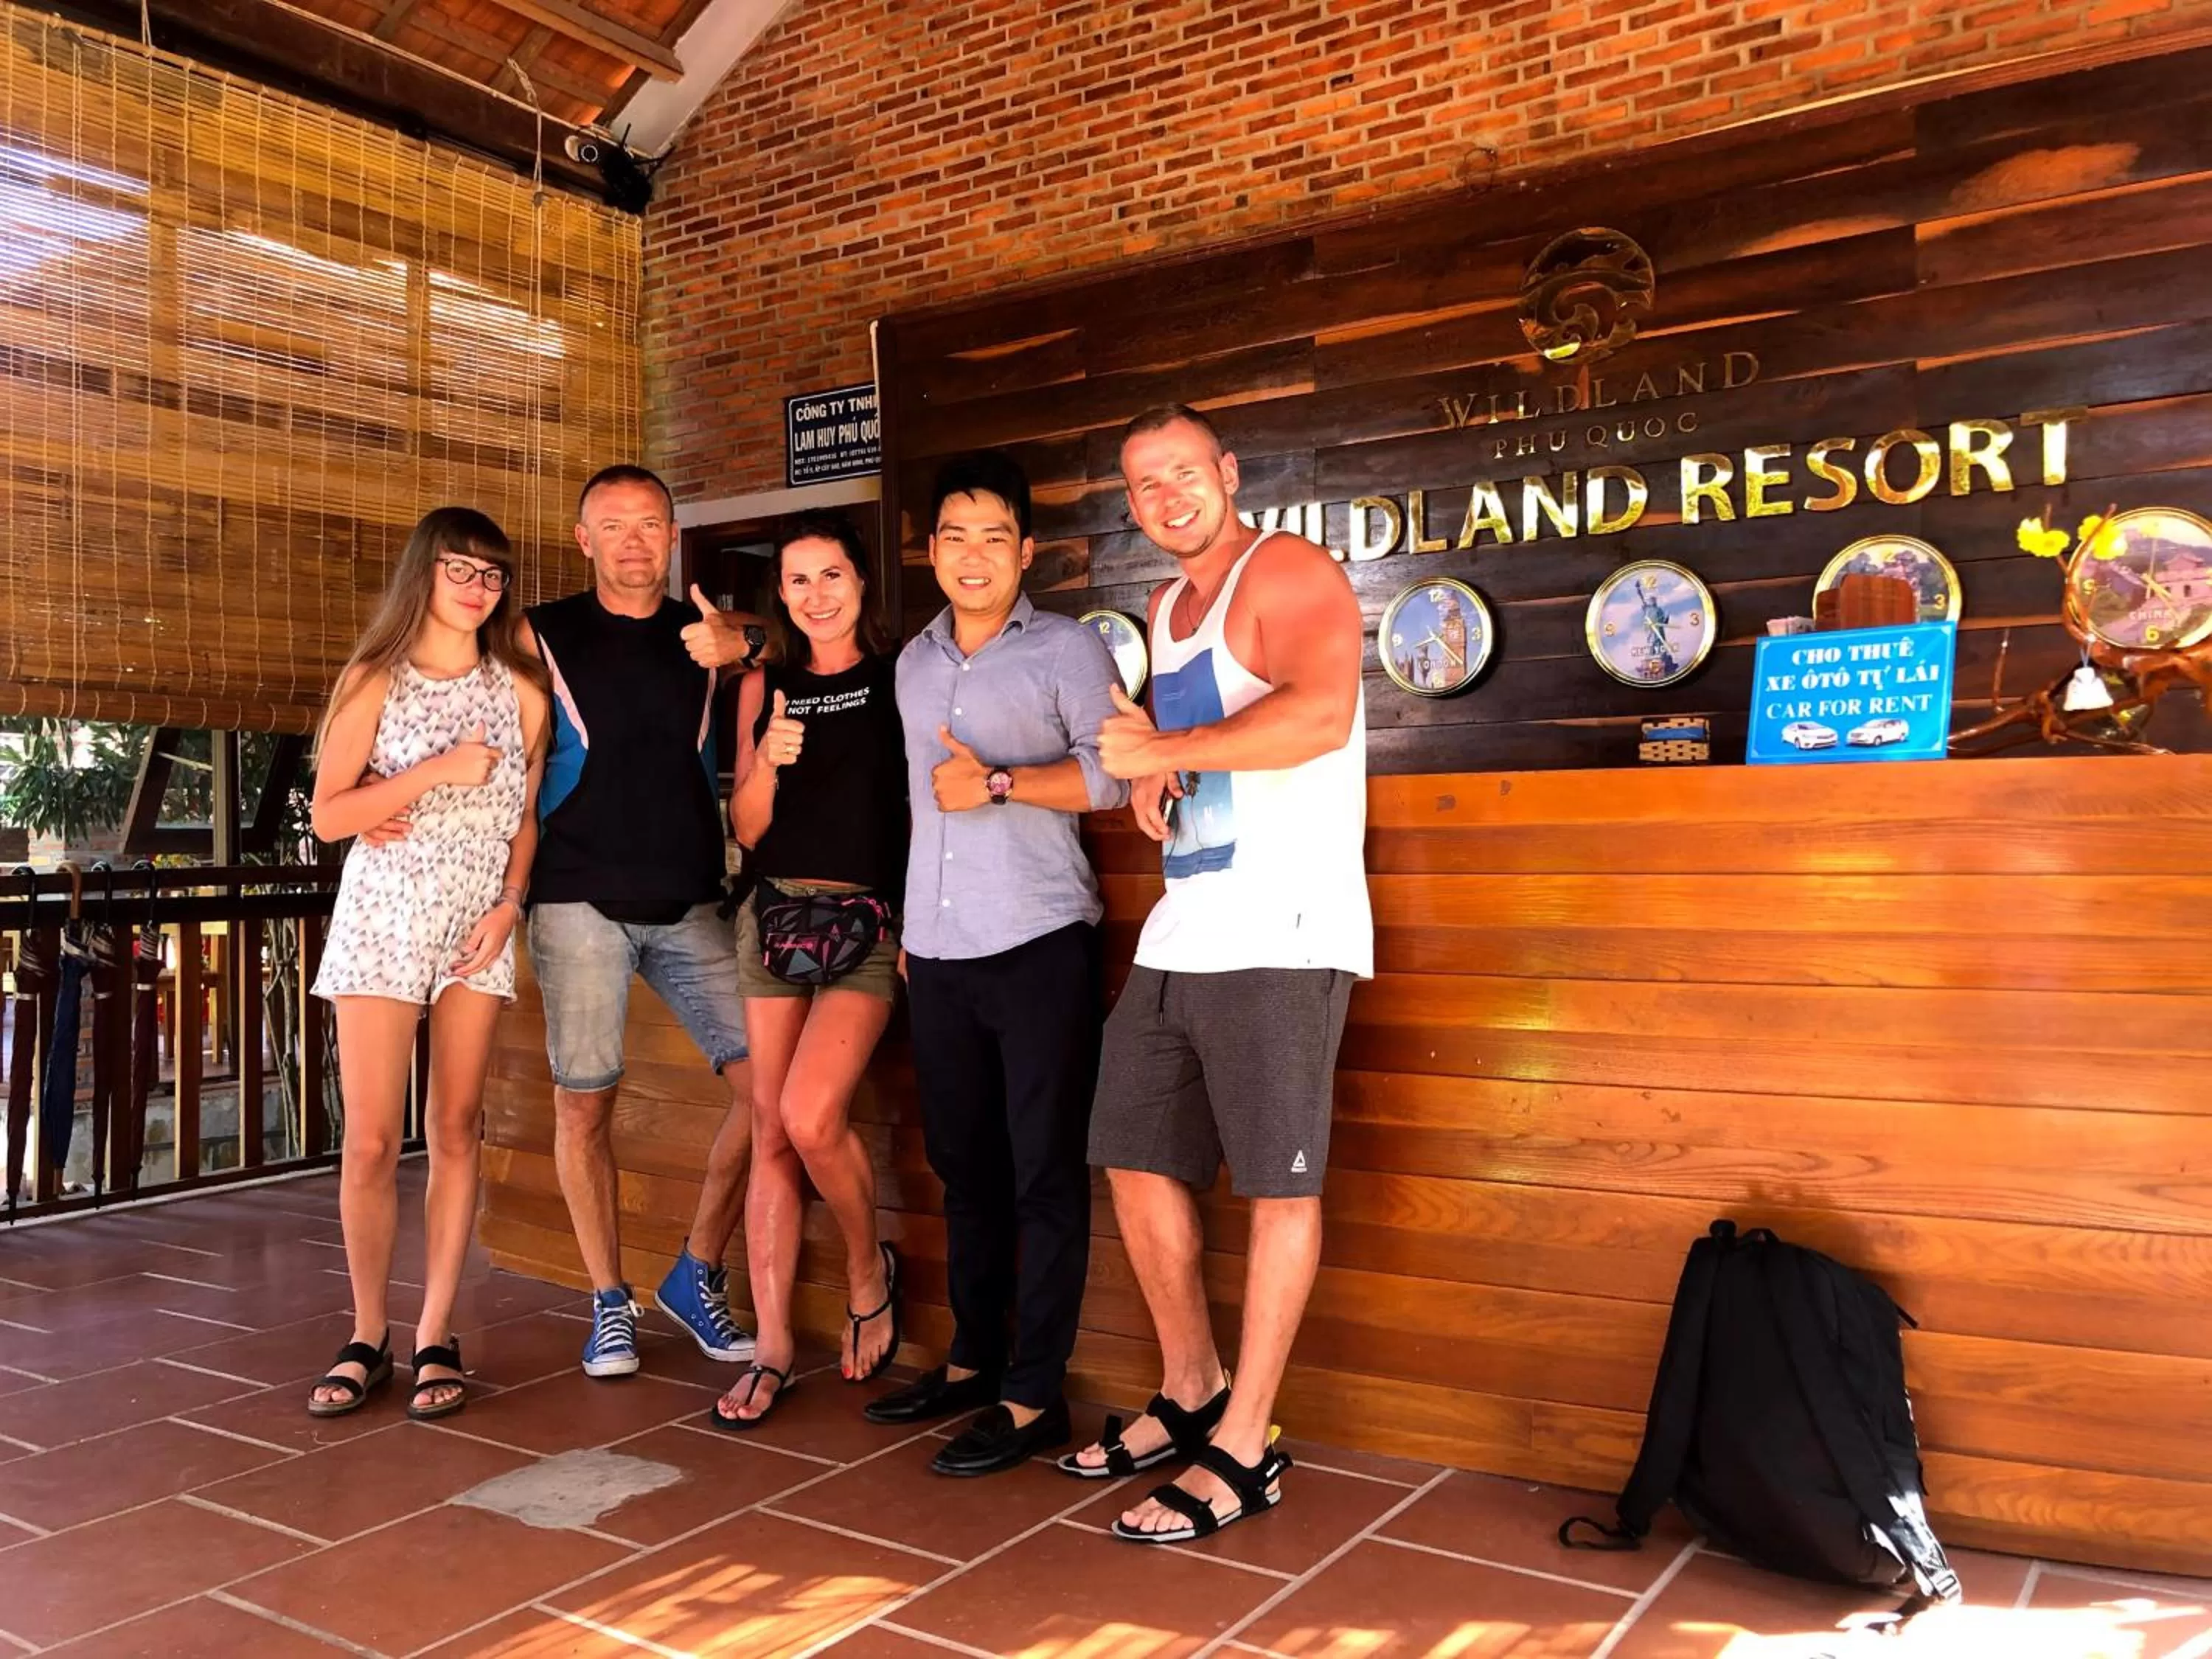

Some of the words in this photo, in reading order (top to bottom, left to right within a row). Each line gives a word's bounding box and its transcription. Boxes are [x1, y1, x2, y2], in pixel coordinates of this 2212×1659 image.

[1436, 351, 1760, 428] WILDLAND
[796, 402, 827, 422] CÔNG
[830, 400, 844, 417] TY
[794, 429, 815, 452] LAM
[816, 425, 836, 448] HUY
[838, 416, 858, 445] PHÚ
[1493, 430, 1567, 459] PHU
[1586, 411, 1699, 448] QUOC
[1680, 406, 2088, 524] RESORT
[1934, 593, 1946, 611] 3
[1690, 613, 1700, 626] 3
[1471, 627, 1481, 641] 3
[2146, 625, 2160, 641] 6
[1792, 647, 1842, 666] CHO
[1847, 636, 1915, 661] THUÊ
[1765, 675, 1796, 692] XE
[1801, 667, 1851, 690] ÔTÔ
[1857, 664, 1892, 691] TỰ
[1895, 659, 1940, 684] LÁI
[787, 705, 812, 714] NOT
[816, 697, 866, 714] FEELINGS
[791, 697, 821, 706] NEED
[823, 686, 870, 704] CLOTHES
[1766, 701, 1812, 719] CAR
[1818, 699, 1862, 717] FOR
[1869, 694, 1933, 715] RENT
